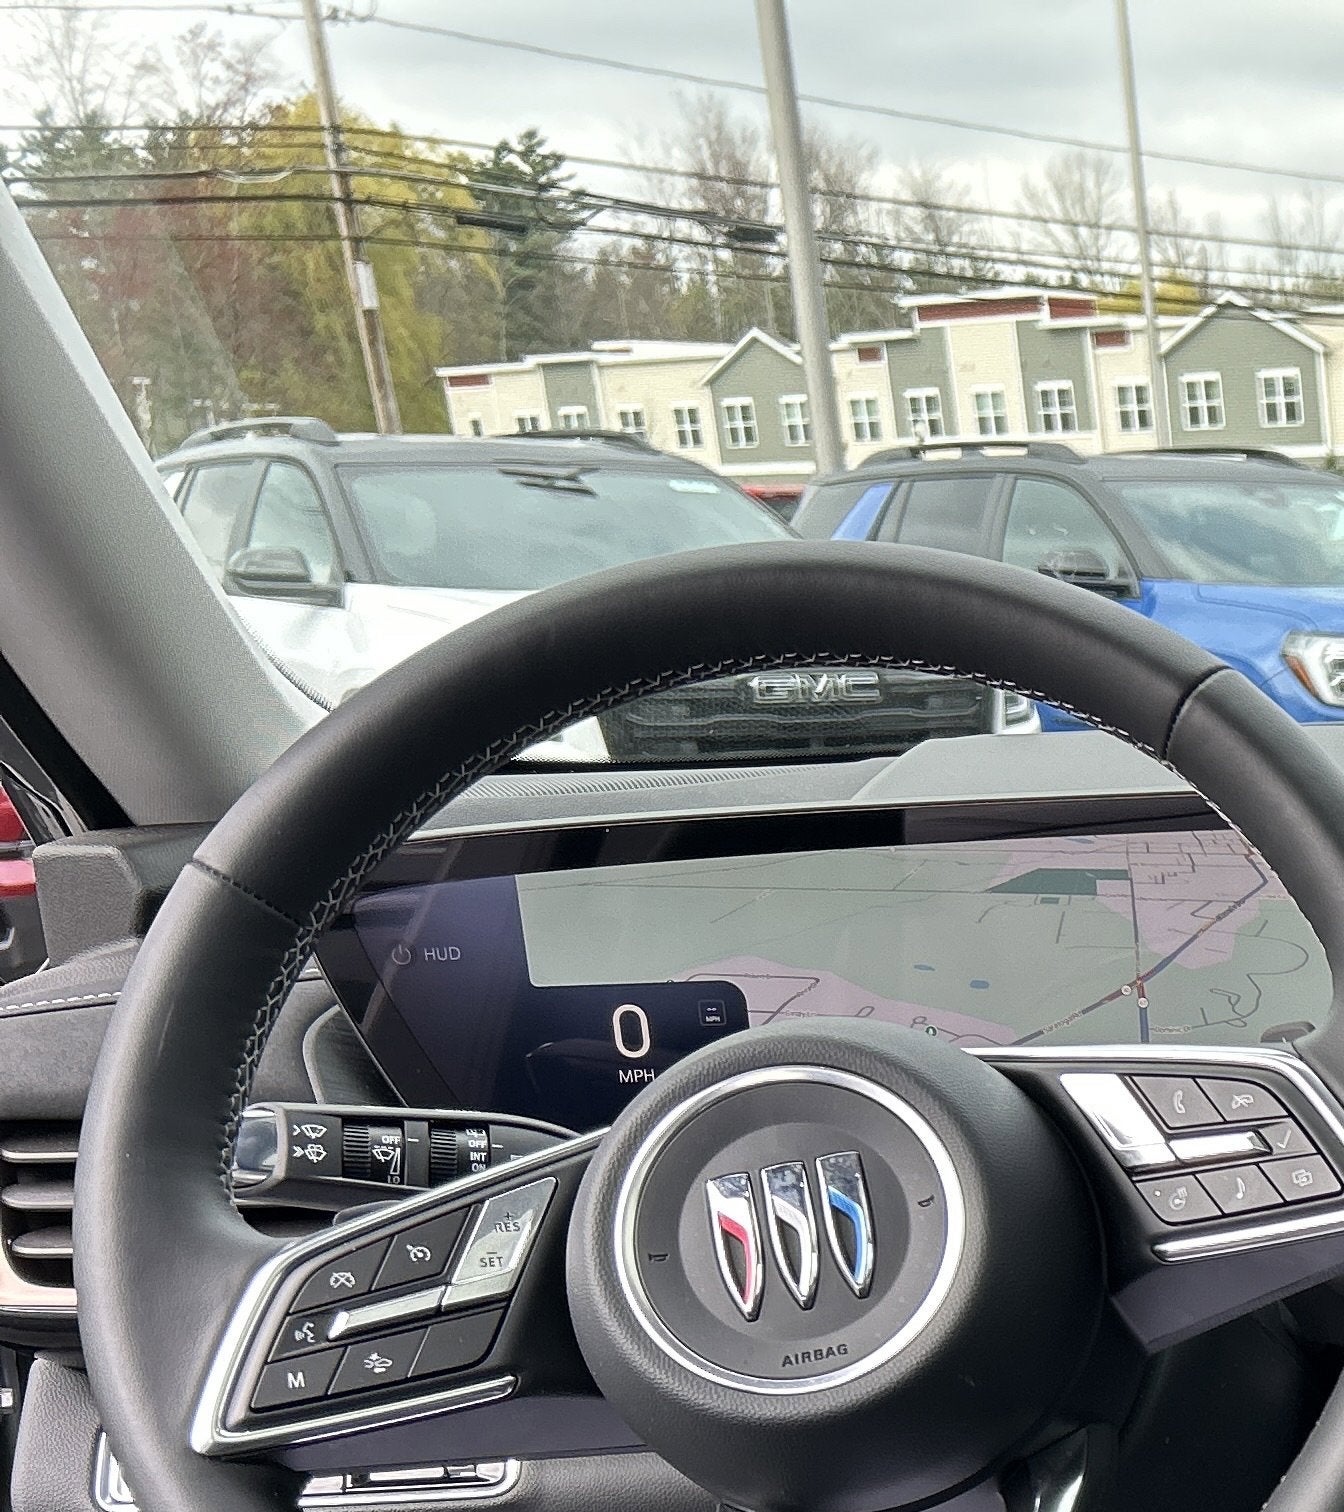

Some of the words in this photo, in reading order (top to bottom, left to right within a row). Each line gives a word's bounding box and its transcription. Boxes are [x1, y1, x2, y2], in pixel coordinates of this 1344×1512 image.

[749, 672, 882, 703] GMC
[424, 946, 461, 961] HUD
[612, 1004, 651, 1058] 0
[618, 1068, 655, 1084] MPH
[381, 1135, 400, 1145] OFF
[468, 1140, 488, 1149] OFF
[470, 1151, 487, 1161] INT
[494, 1221, 521, 1233] RES
[479, 1256, 503, 1268] SET
[781, 1344, 849, 1368] AIRBAG
[287, 1371, 306, 1389] M
